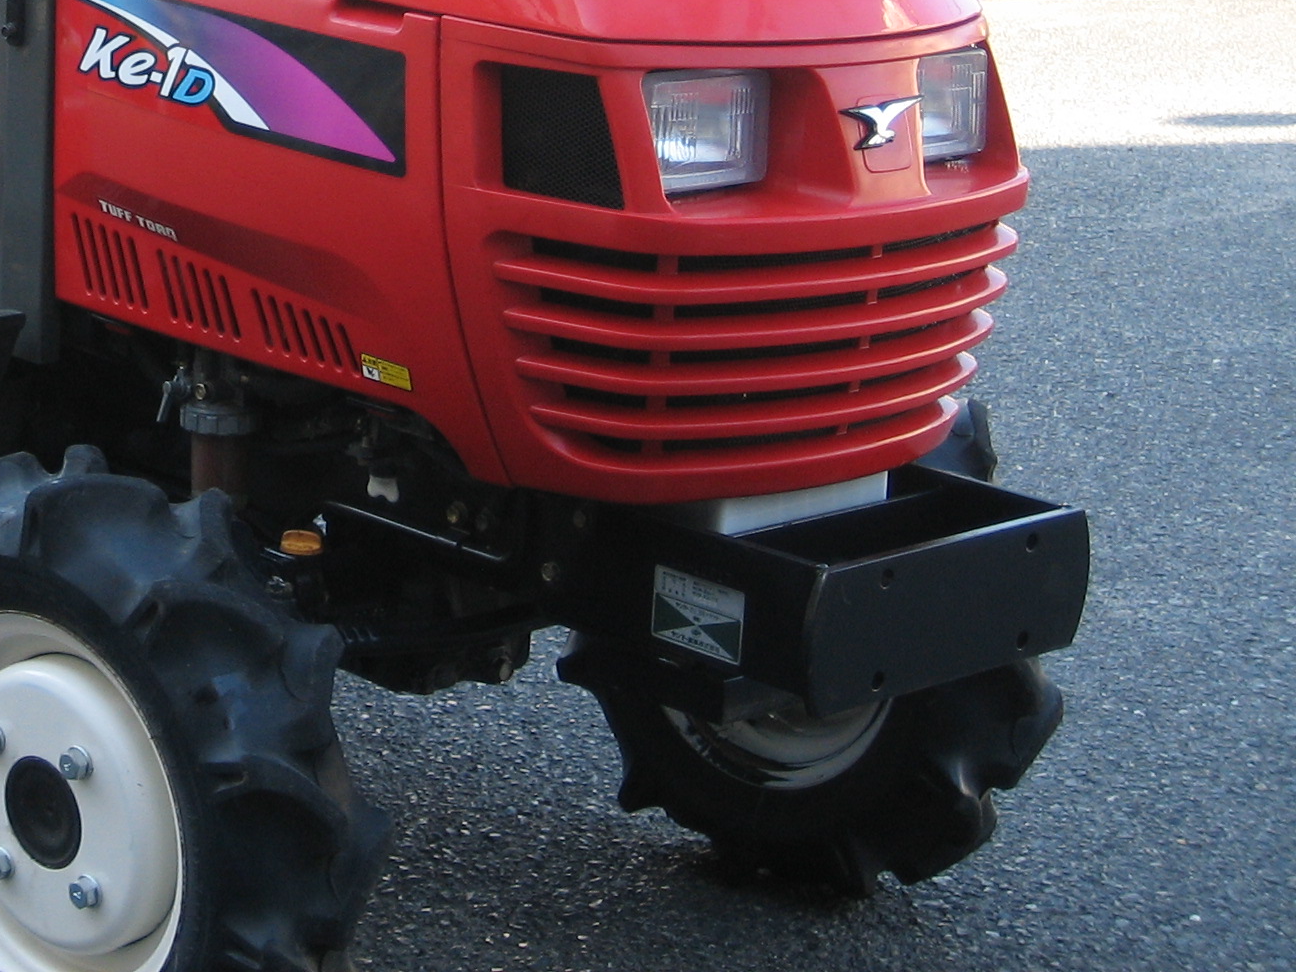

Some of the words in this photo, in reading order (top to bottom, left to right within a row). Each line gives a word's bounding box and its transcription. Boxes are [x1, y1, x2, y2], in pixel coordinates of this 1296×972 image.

[78, 27, 216, 106] Ke-1D
[97, 199, 132, 222] TUFF
[135, 215, 178, 242] TORQ
